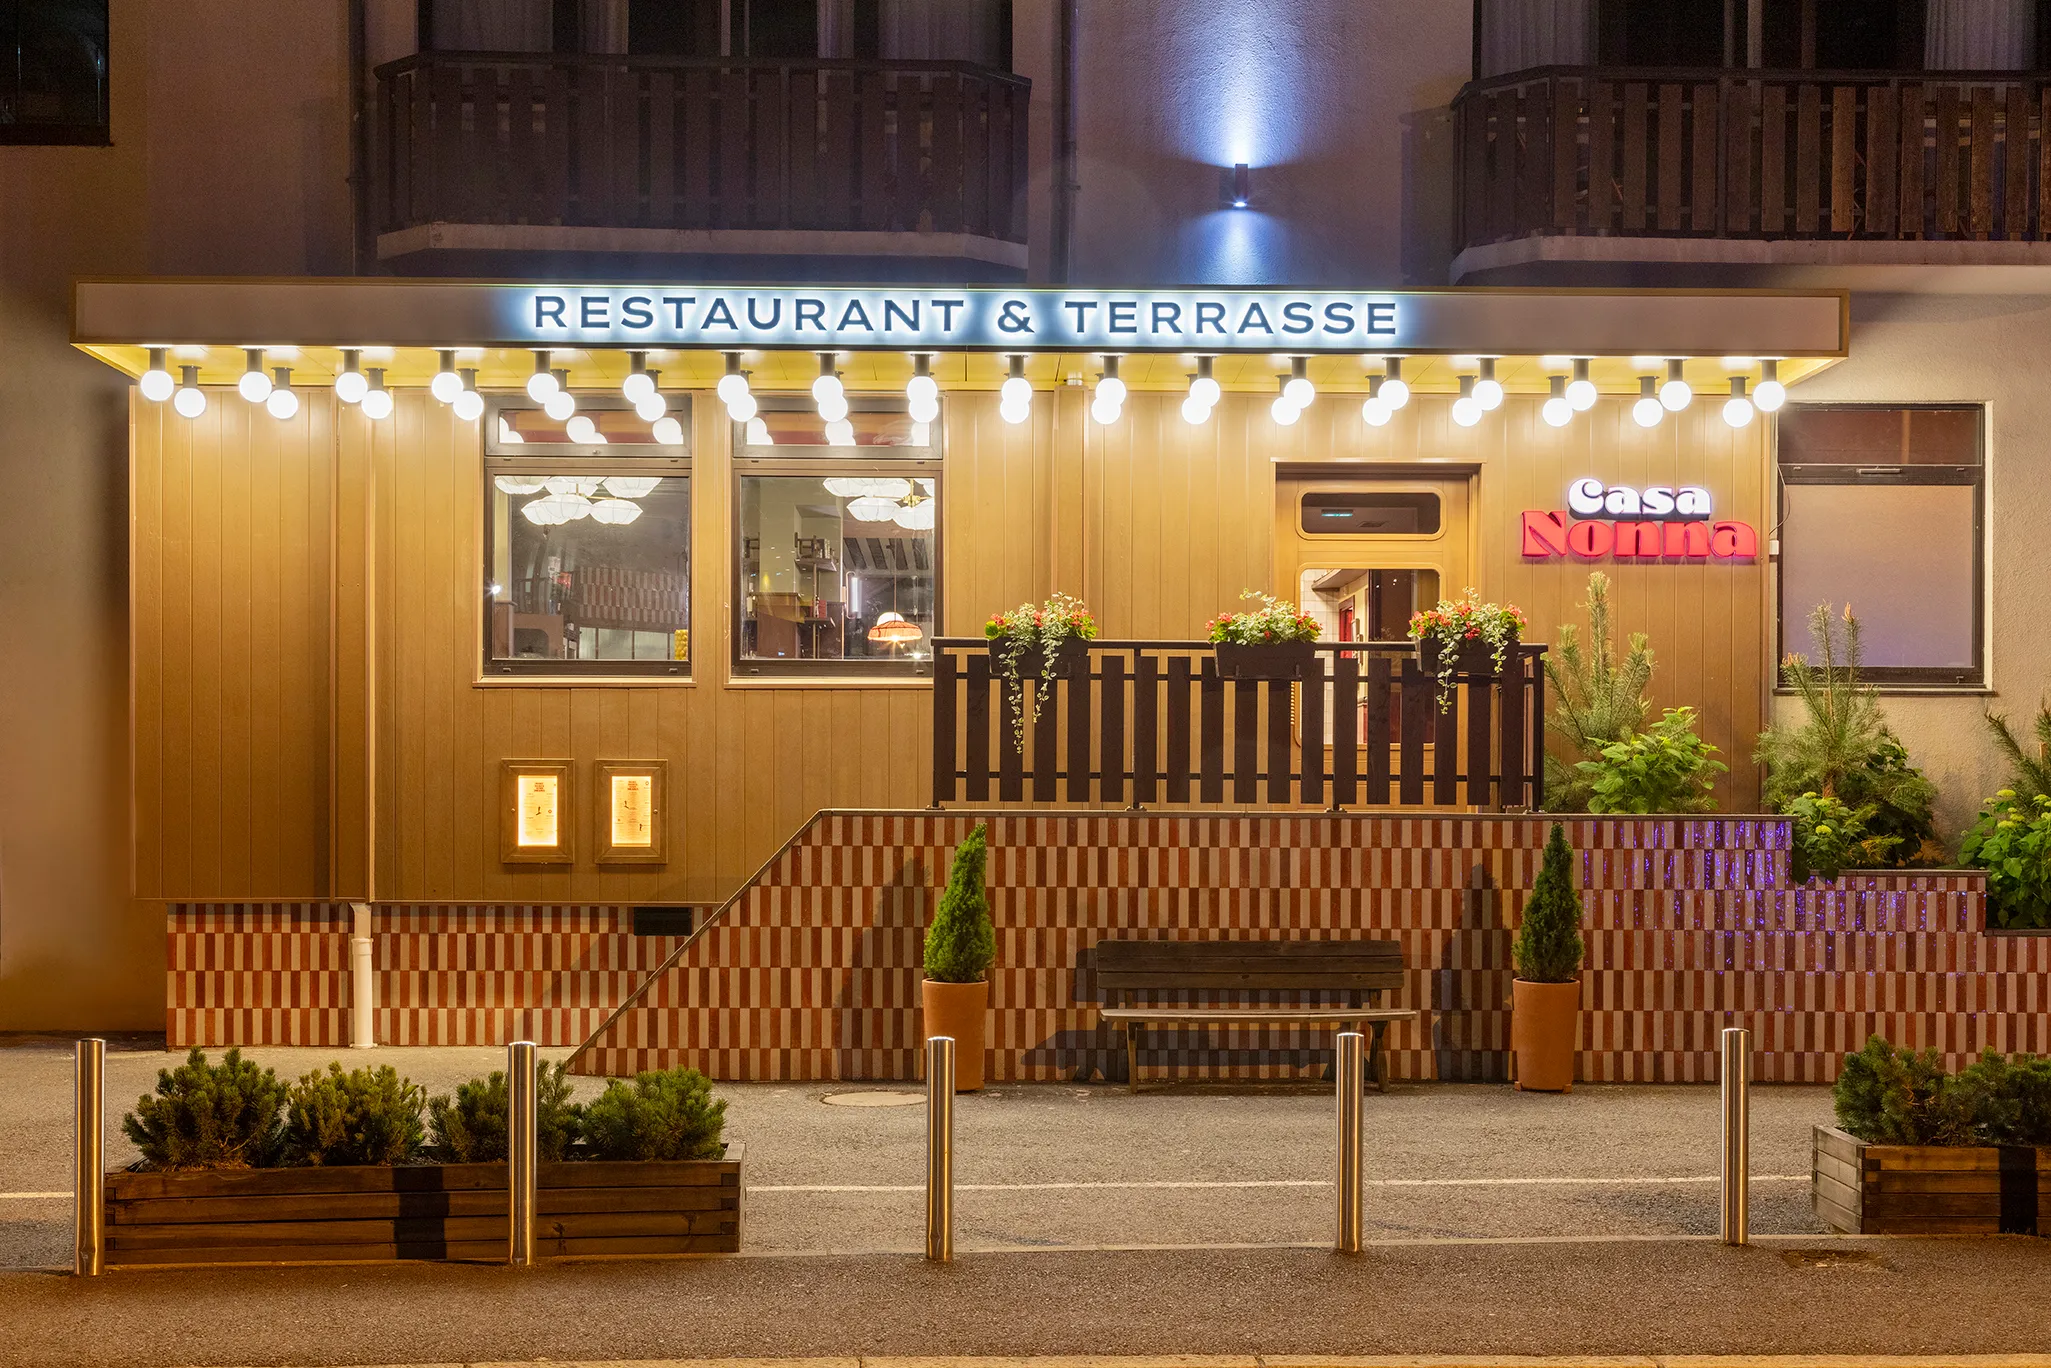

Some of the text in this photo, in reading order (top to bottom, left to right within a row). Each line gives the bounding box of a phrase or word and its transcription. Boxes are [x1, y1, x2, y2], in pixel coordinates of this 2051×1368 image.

[535, 295, 1397, 335] RESTAURANT & TERRASSE
[1567, 478, 1713, 517] Casa
[1521, 511, 1757, 557] Nonna
